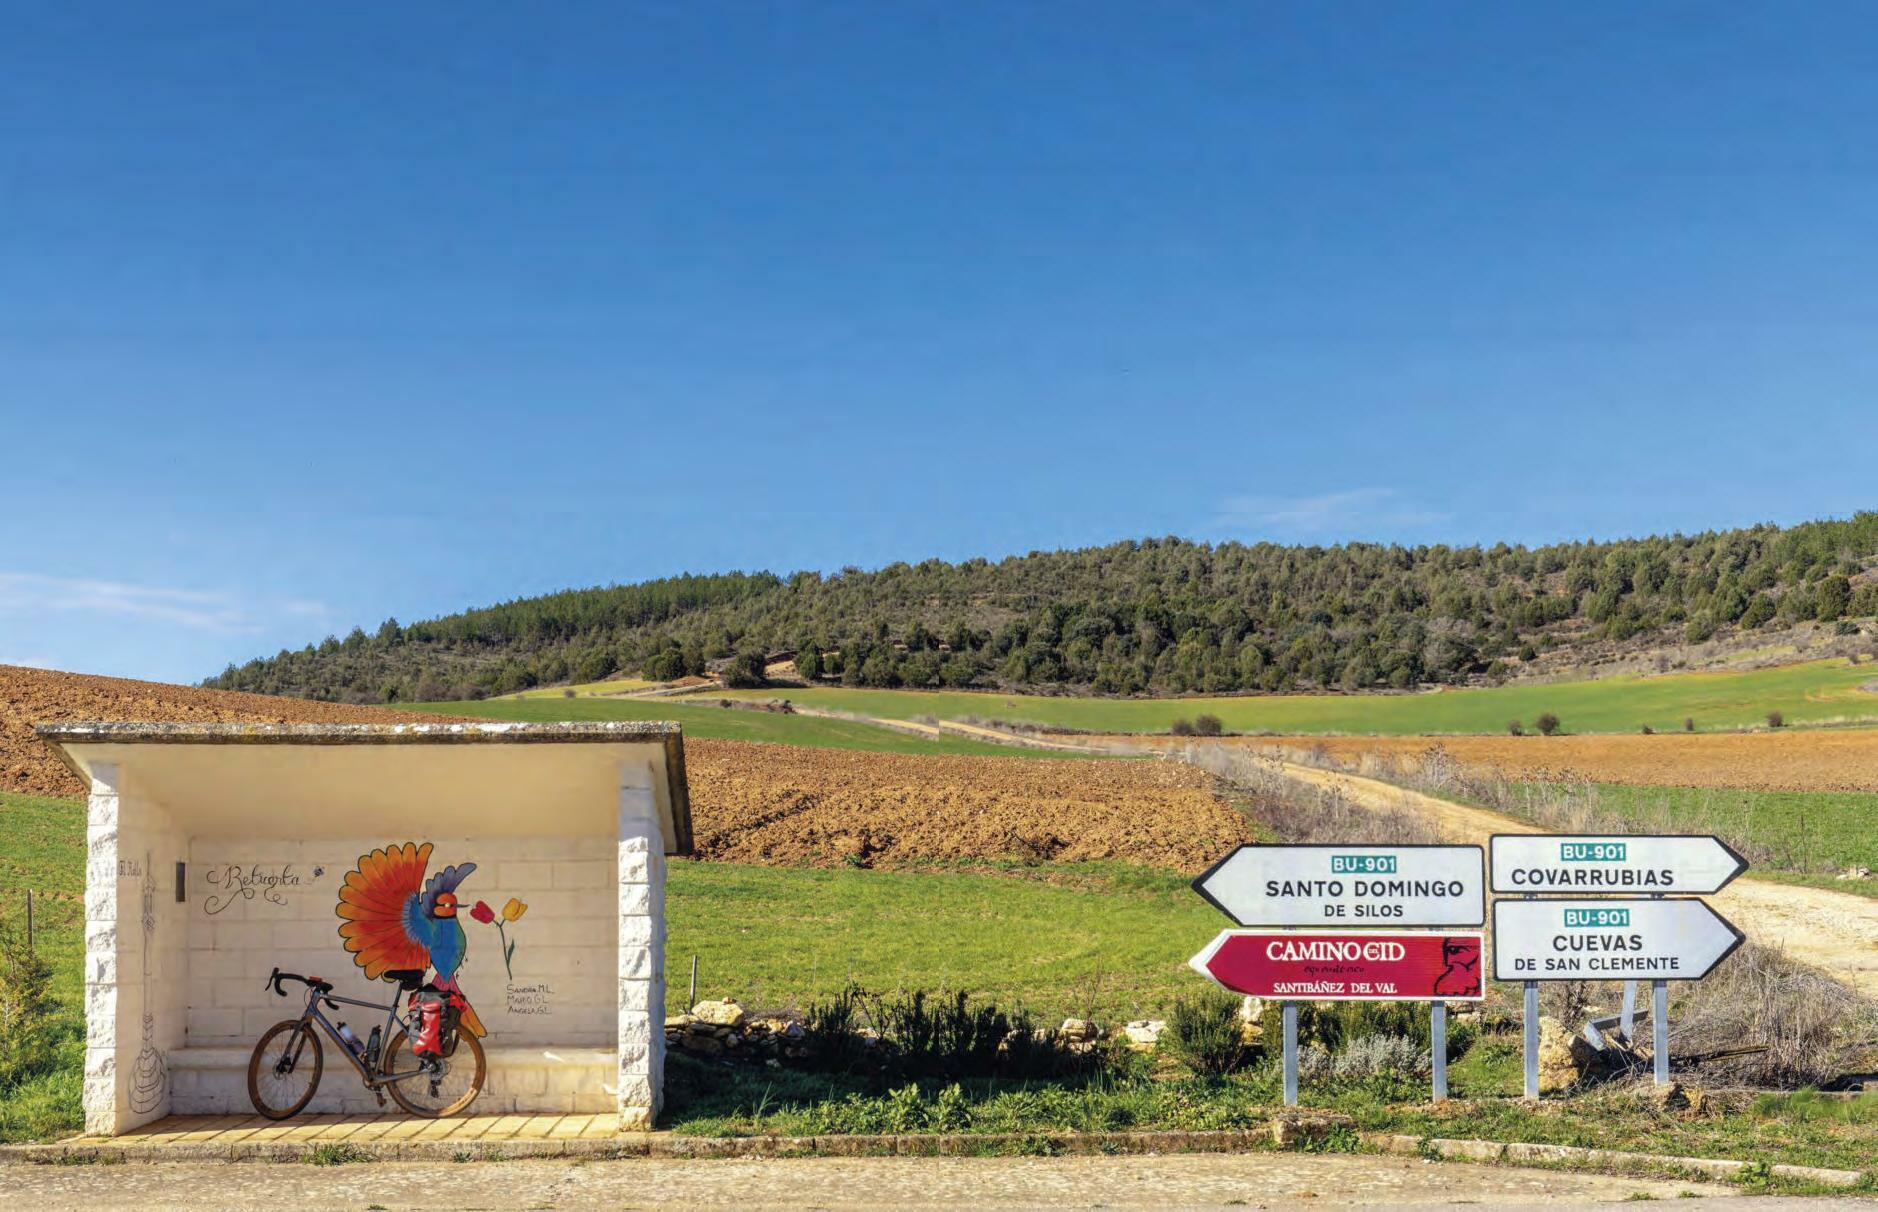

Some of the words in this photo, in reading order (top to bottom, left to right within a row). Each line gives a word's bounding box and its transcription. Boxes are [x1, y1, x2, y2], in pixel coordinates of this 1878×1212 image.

[1562, 844, 1625, 859] BU-901
[1332, 857, 1396, 872] BU-901
[1511, 868, 1674, 886] COVARRUBIAS
[1265, 880, 1343, 897] SANTO
[1354, 880, 1464, 897] DOMINGO
[1324, 904, 1346, 917] DE
[1354, 904, 1403, 917] SILOS
[1566, 910, 1628, 925] BU-901
[1552, 934, 1643, 952] CUEVAS
[1266, 941, 1361, 961] CAMINO
[1363, 942, 1405, 961] CID
[1515, 958, 1536, 970] DE
[1545, 958, 1580, 970] SAN
[1588, 957, 1680, 970] CLEMENTE
[1273, 980, 1345, 993] SANTIBÁÑEZ
[1350, 982, 1373, 993] DEL
[1375, 982, 1398, 993] VAL
